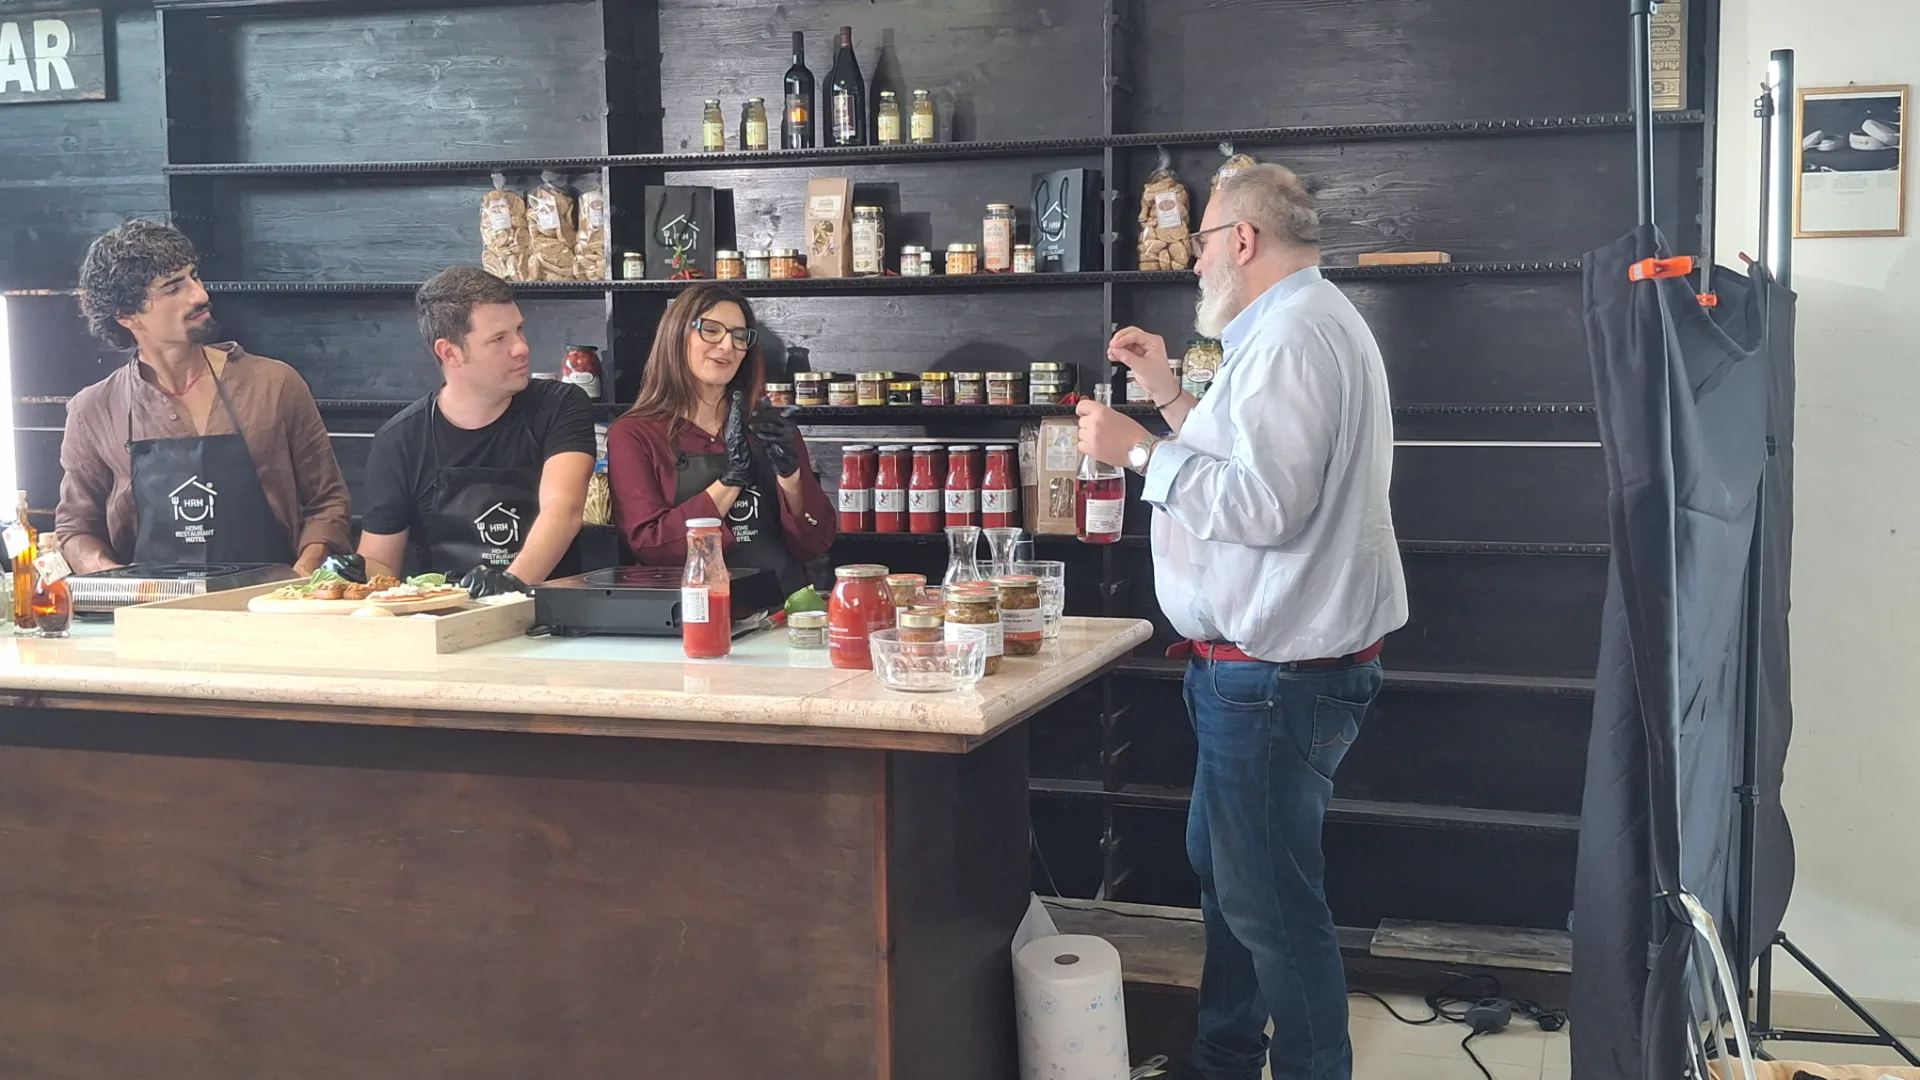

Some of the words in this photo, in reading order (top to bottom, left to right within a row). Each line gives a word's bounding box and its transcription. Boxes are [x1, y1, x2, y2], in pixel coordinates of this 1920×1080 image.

[184, 498, 204, 508] HRH
[489, 523, 508, 532] HRH
[175, 529, 215, 538] RESTAURANT
